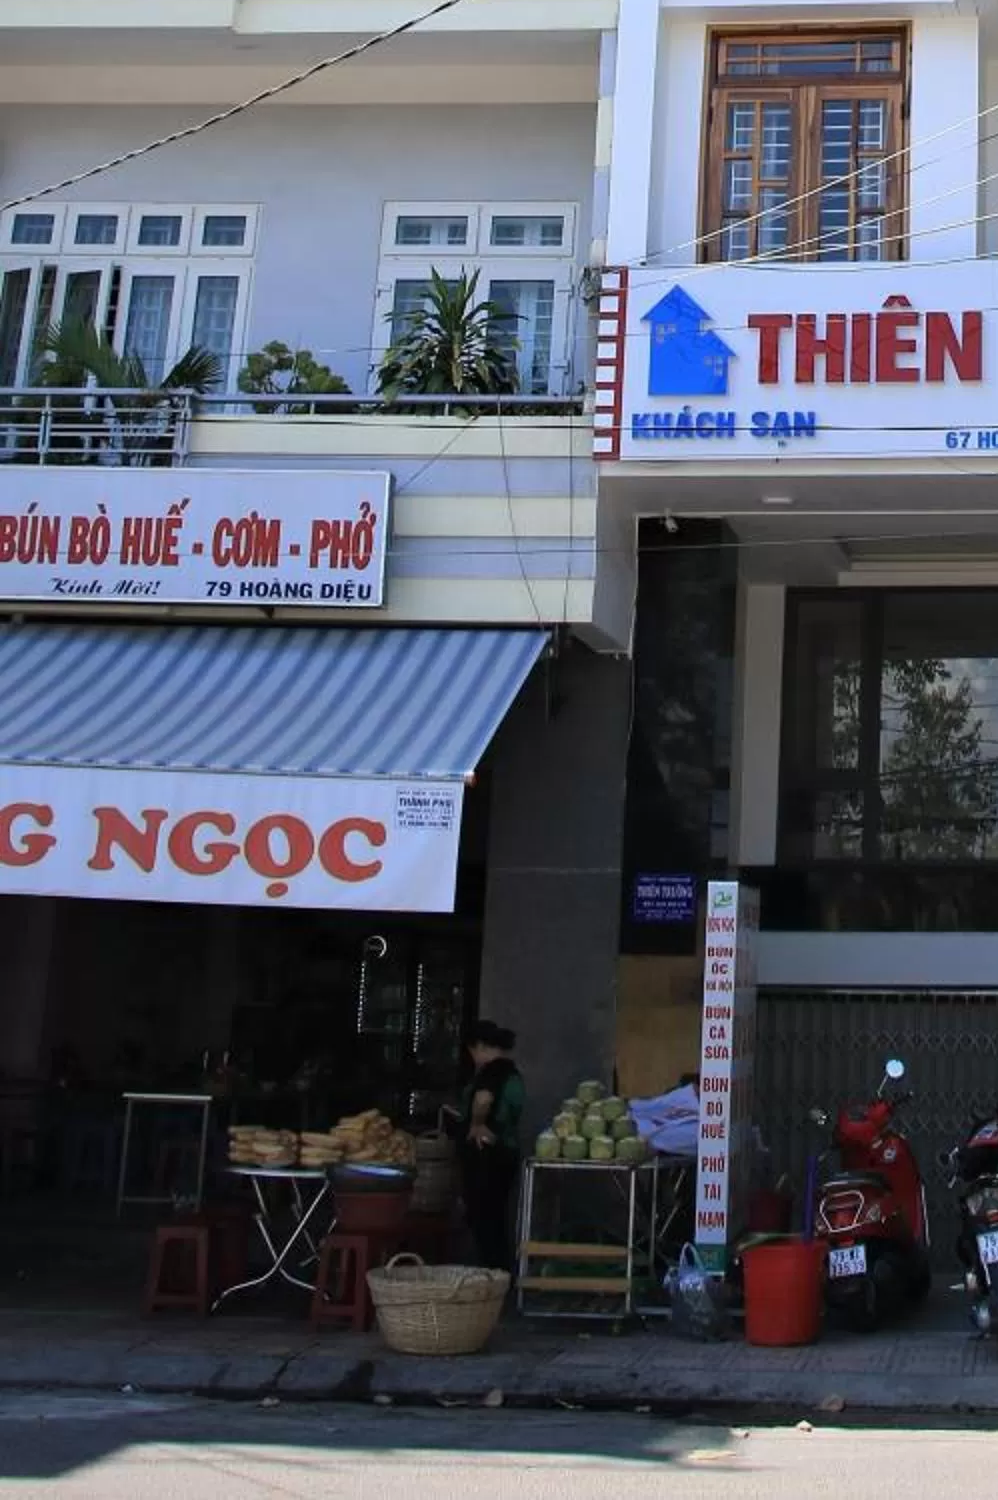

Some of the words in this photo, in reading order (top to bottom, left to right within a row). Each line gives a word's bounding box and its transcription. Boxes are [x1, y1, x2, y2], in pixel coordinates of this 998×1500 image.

[748, 294, 983, 384] THIÊN
[631, 405, 736, 440] KHÁCH
[751, 411, 817, 447] SẠN
[945, 430, 972, 449] 67
[0, 502, 61, 564] BÚN
[67, 503, 111, 565] BÒ
[119, 498, 191, 566] HUẾ
[211, 511, 281, 569] CƠM
[309, 501, 378, 570] PHỞ
[206, 581, 232, 597] 79
[239, 578, 313, 598] HOÀNG
[319, 579, 372, 602] DIỆU
[87, 807, 387, 898] NGỌC
